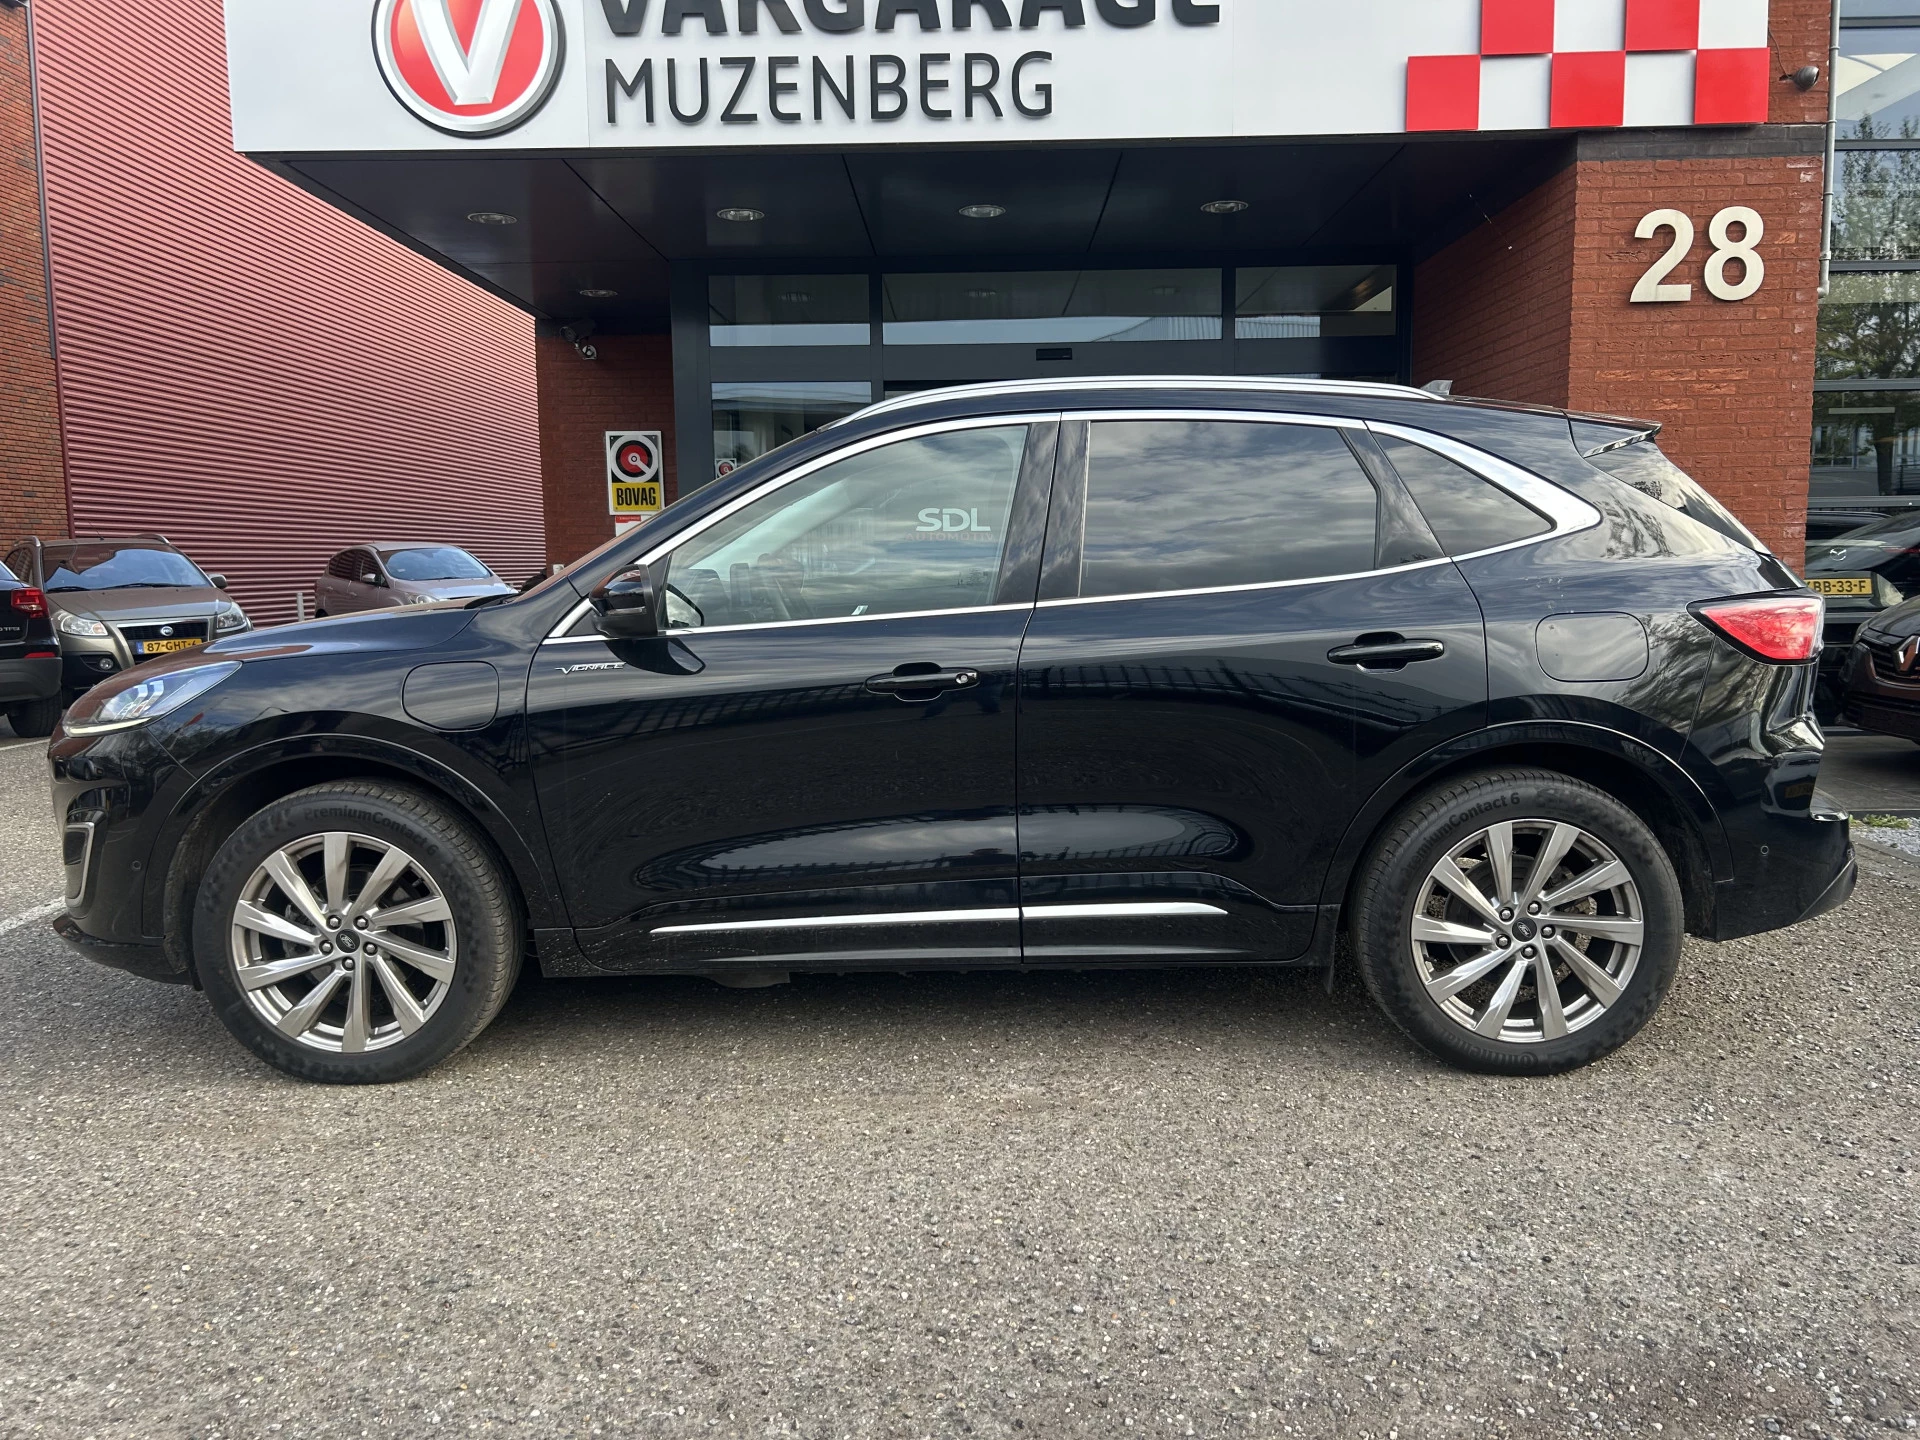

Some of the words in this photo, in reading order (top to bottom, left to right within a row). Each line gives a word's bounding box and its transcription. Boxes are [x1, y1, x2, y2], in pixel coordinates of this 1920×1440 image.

[605, 51, 1052, 124] MUZENBERG
[1630, 206, 1764, 302] 28
[616, 487, 656, 506] BOVAG
[916, 507, 991, 532] SDL
[1806, 580, 1866, 593] BB-33-F
